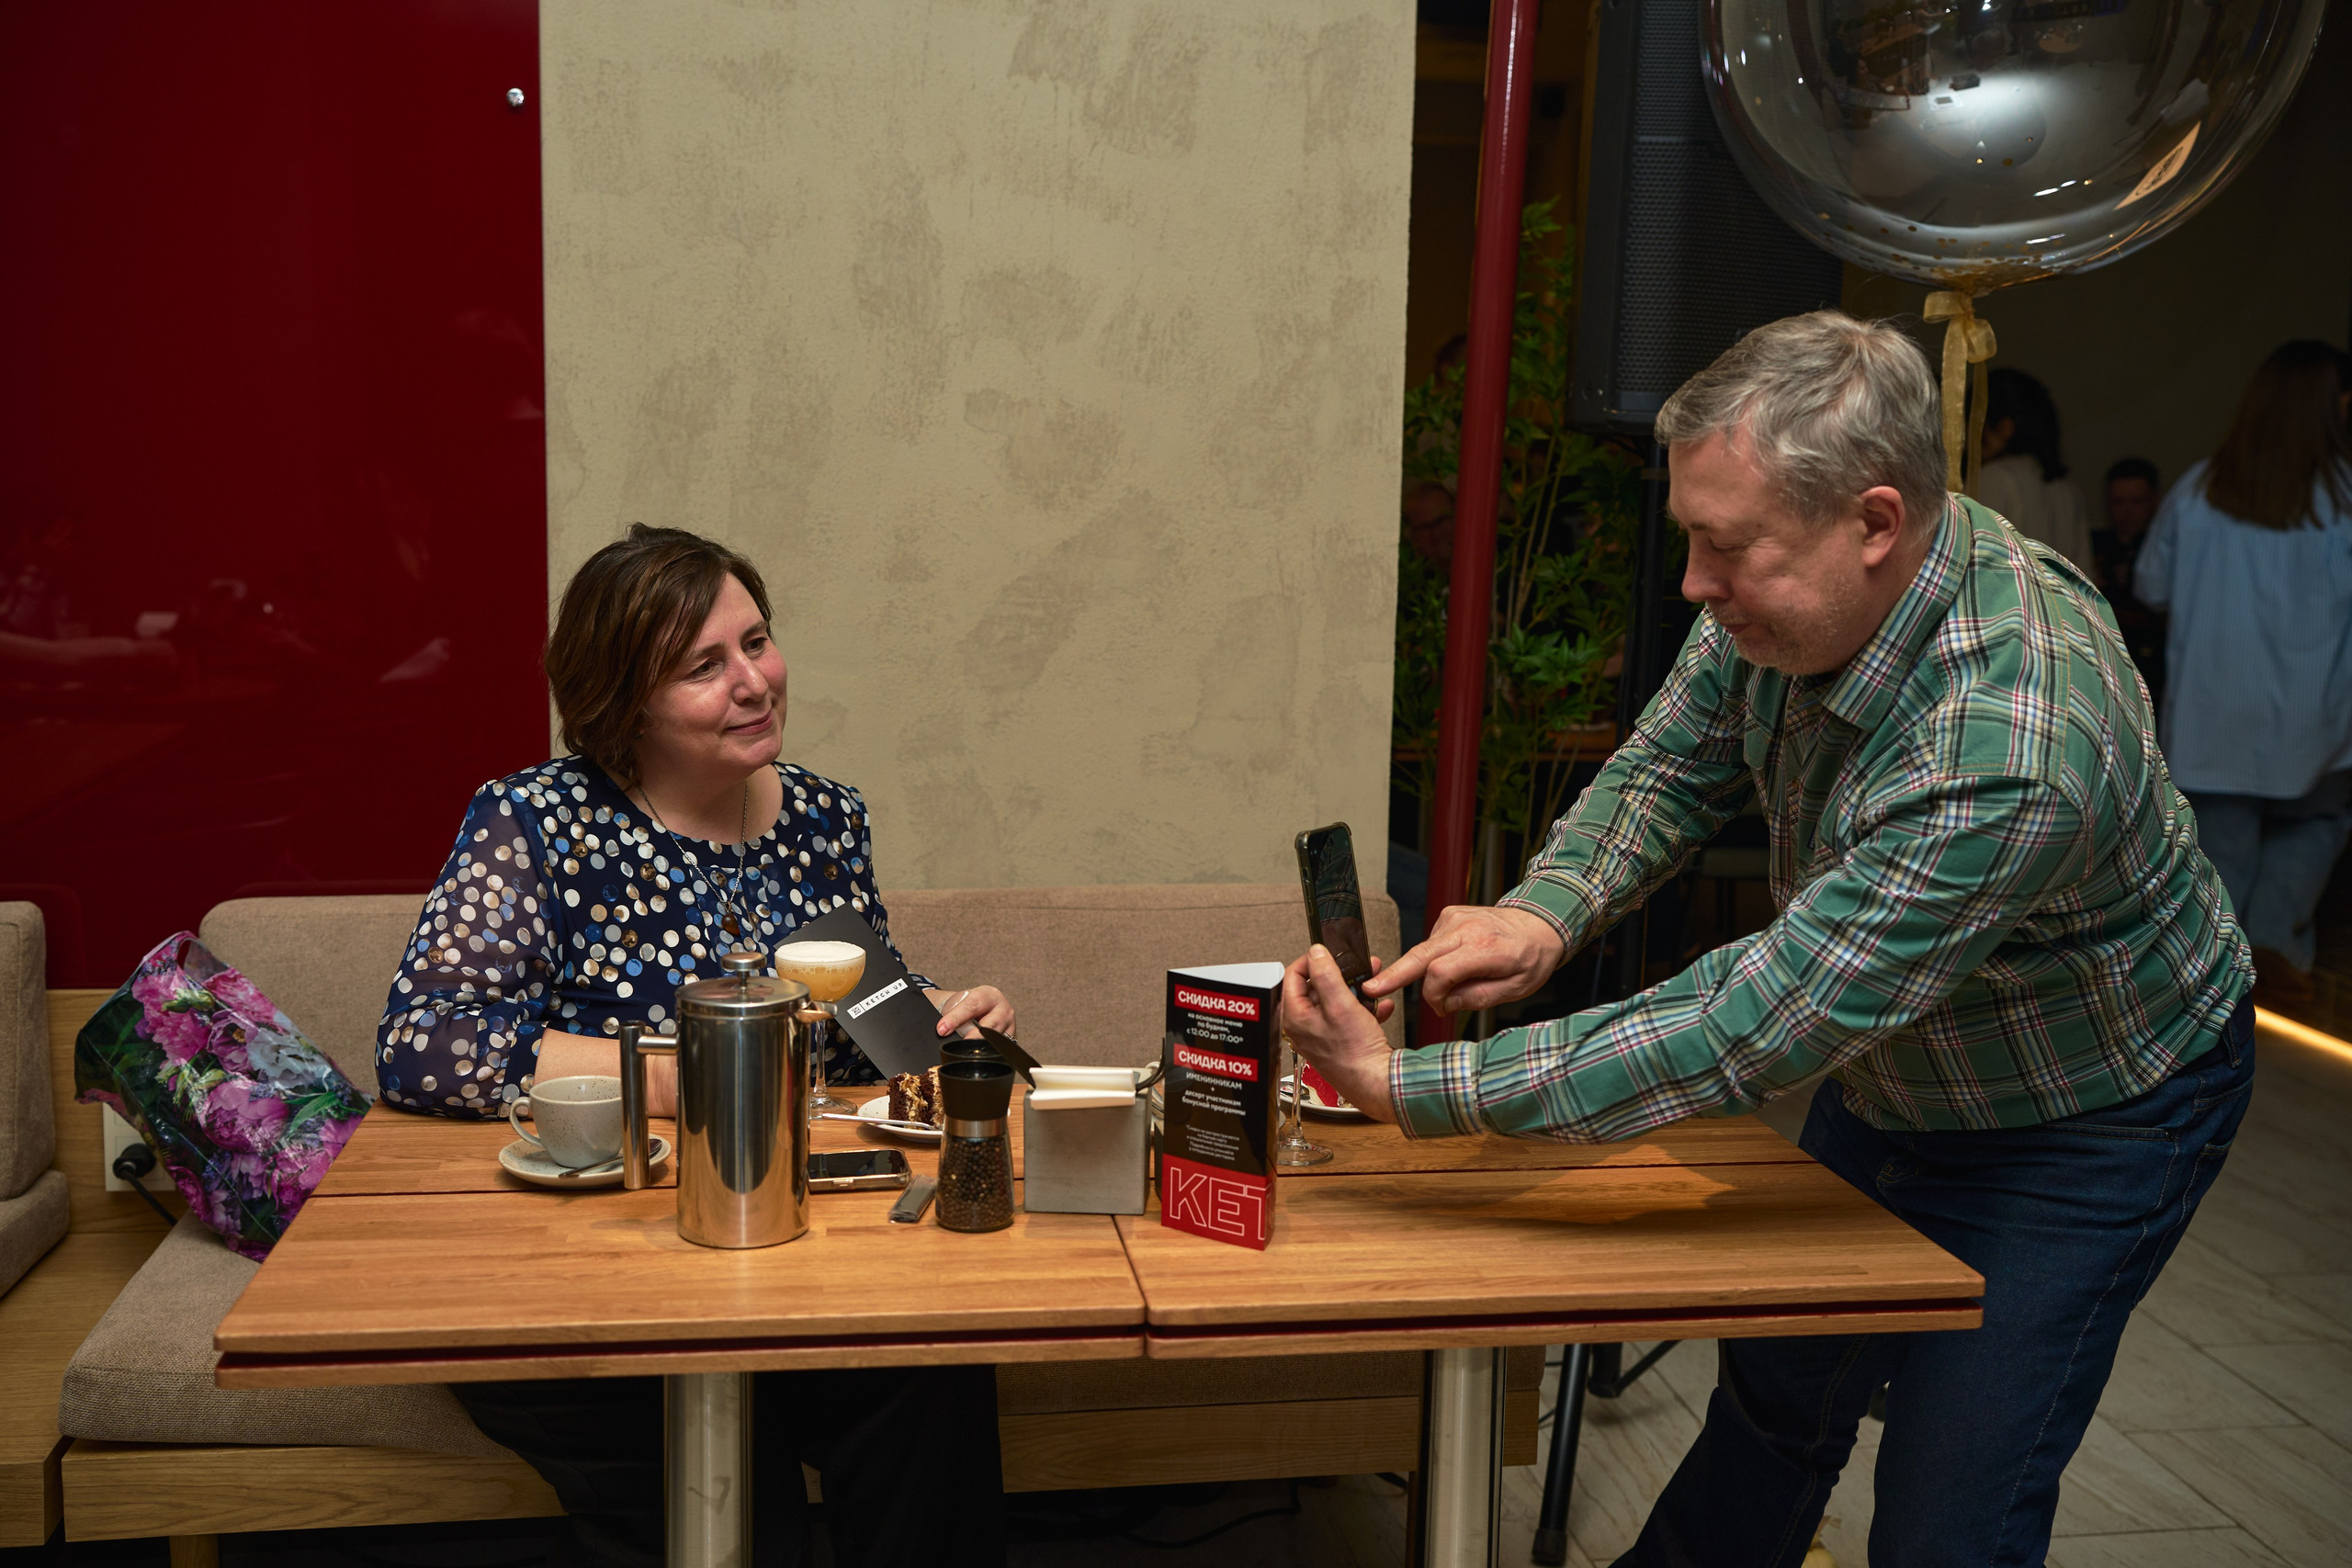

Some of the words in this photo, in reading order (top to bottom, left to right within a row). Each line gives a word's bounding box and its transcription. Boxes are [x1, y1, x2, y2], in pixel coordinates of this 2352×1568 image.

[865, 989, 890, 1006] KETCH
[893, 982, 902, 990] UP
[1178, 990, 1227, 1011] СКИДКА
[1227, 999, 1256, 1016] 20%
[1195, 1013, 1224, 1024] основное
[1225, 1020, 1243, 1028] меню
[1191, 1027, 1210, 1038] 12:00
[1178, 1050, 1227, 1071] СКИДКА
[1227, 1061, 1252, 1077] 10%
[1186, 1071, 1242, 1089] ИМЕНИННИКАМ
[1182, 1096, 1210, 1108] бонусной
[1184, 1089, 1204, 1100] десерт
[1205, 1095, 1241, 1106] участникам
